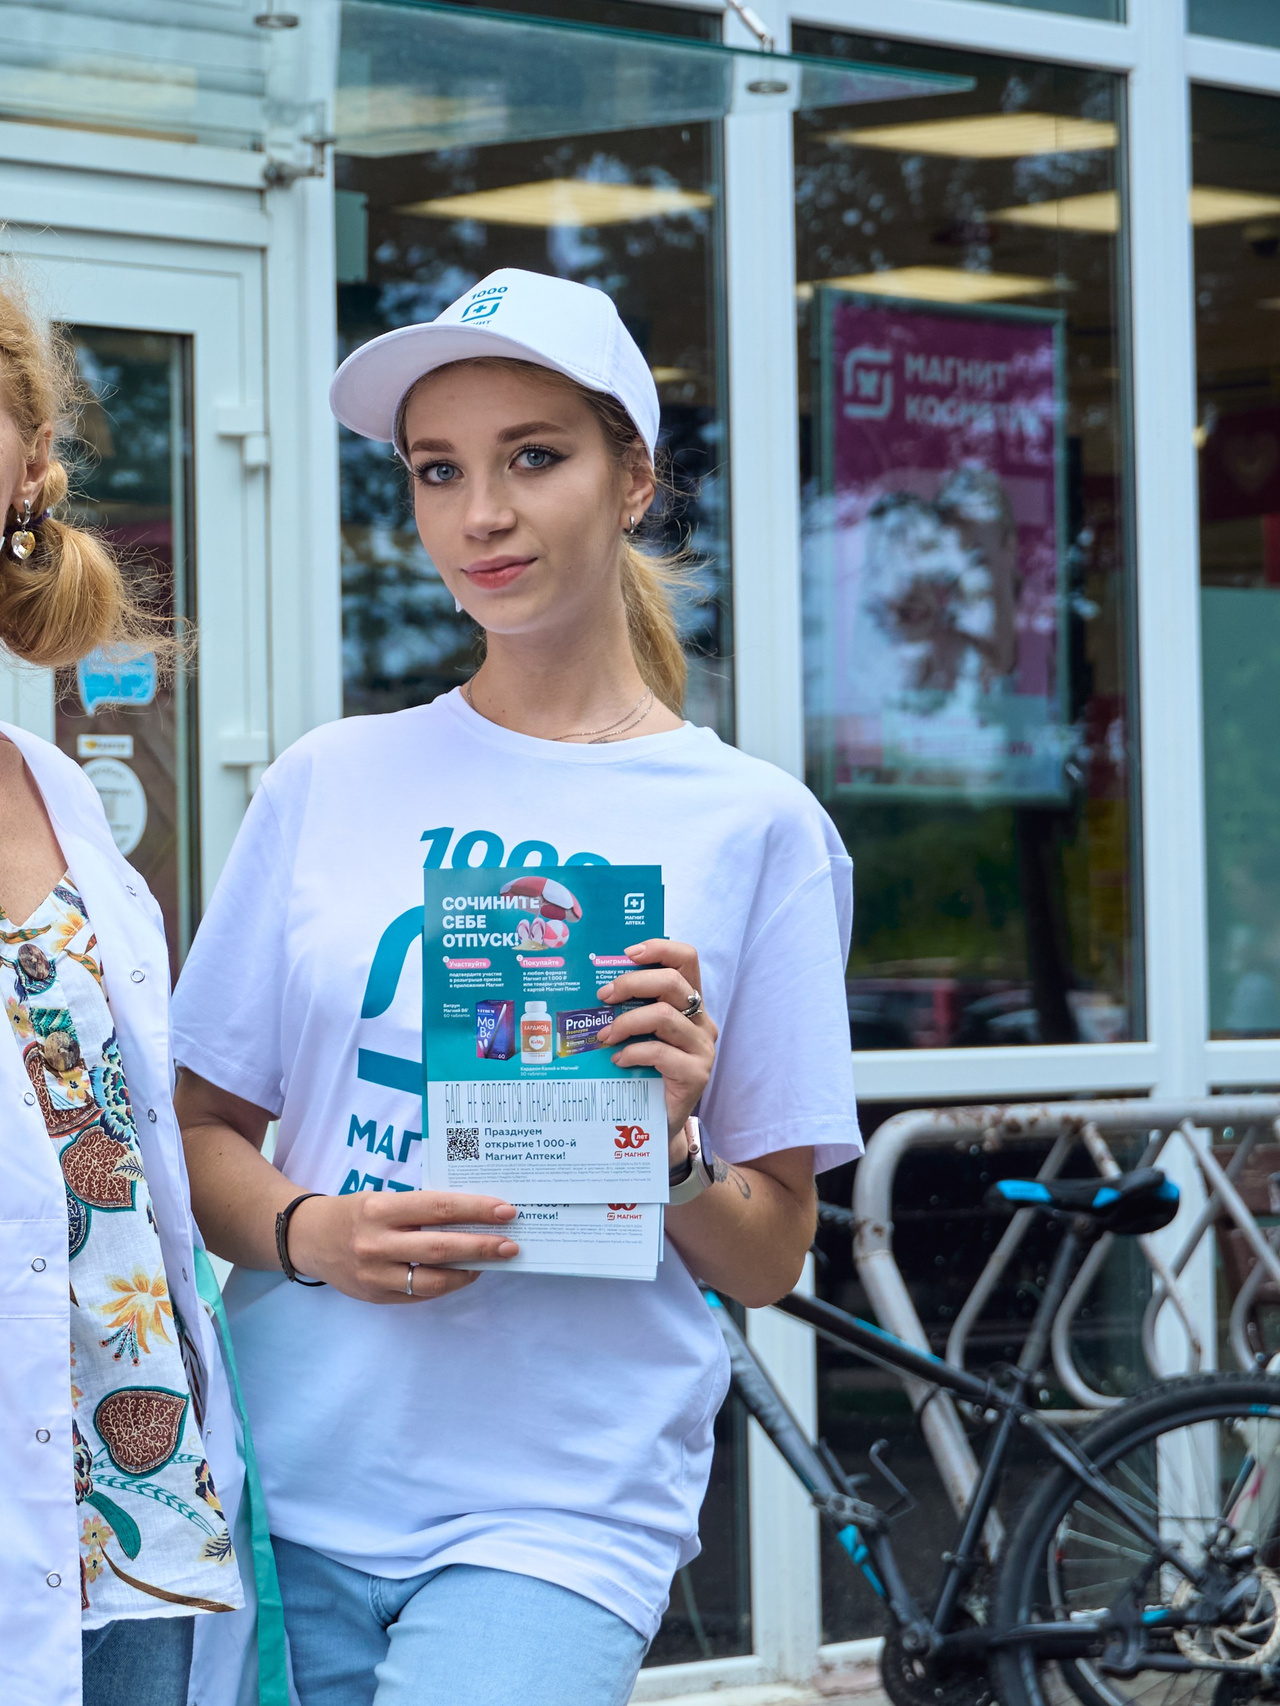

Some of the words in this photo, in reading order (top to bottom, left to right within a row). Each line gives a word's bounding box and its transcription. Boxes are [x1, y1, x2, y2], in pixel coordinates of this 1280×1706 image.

[472, 287, 508, 300] 1000
[905, 353, 1006, 388] МАГНИТ
[442, 896, 539, 911] СОЧИНИТЕ
[442, 915, 486, 929] СЕБЕ
[442, 932, 519, 948] ОТПУСК!
[477, 1016, 495, 1029] Mg
[565, 1014, 613, 1030] Probielle
[468, 1083, 477, 1123] НЕ
[481, 1082, 521, 1123] ЯВЛЯЕТСЯ
[526, 1081, 597, 1122] ЛЕКАРСТВЕННЫМ
[600, 1080, 650, 1122] СРЕДСТВОМ
[347, 1113, 422, 1163] МАГ
[485, 1128, 542, 1137] Празднуем
[485, 1139, 534, 1149] открытие
[485, 1152, 522, 1160] Магнит
[525, 1151, 566, 1160] Аптеки!
[518, 1211, 559, 1220] Аптеки!
